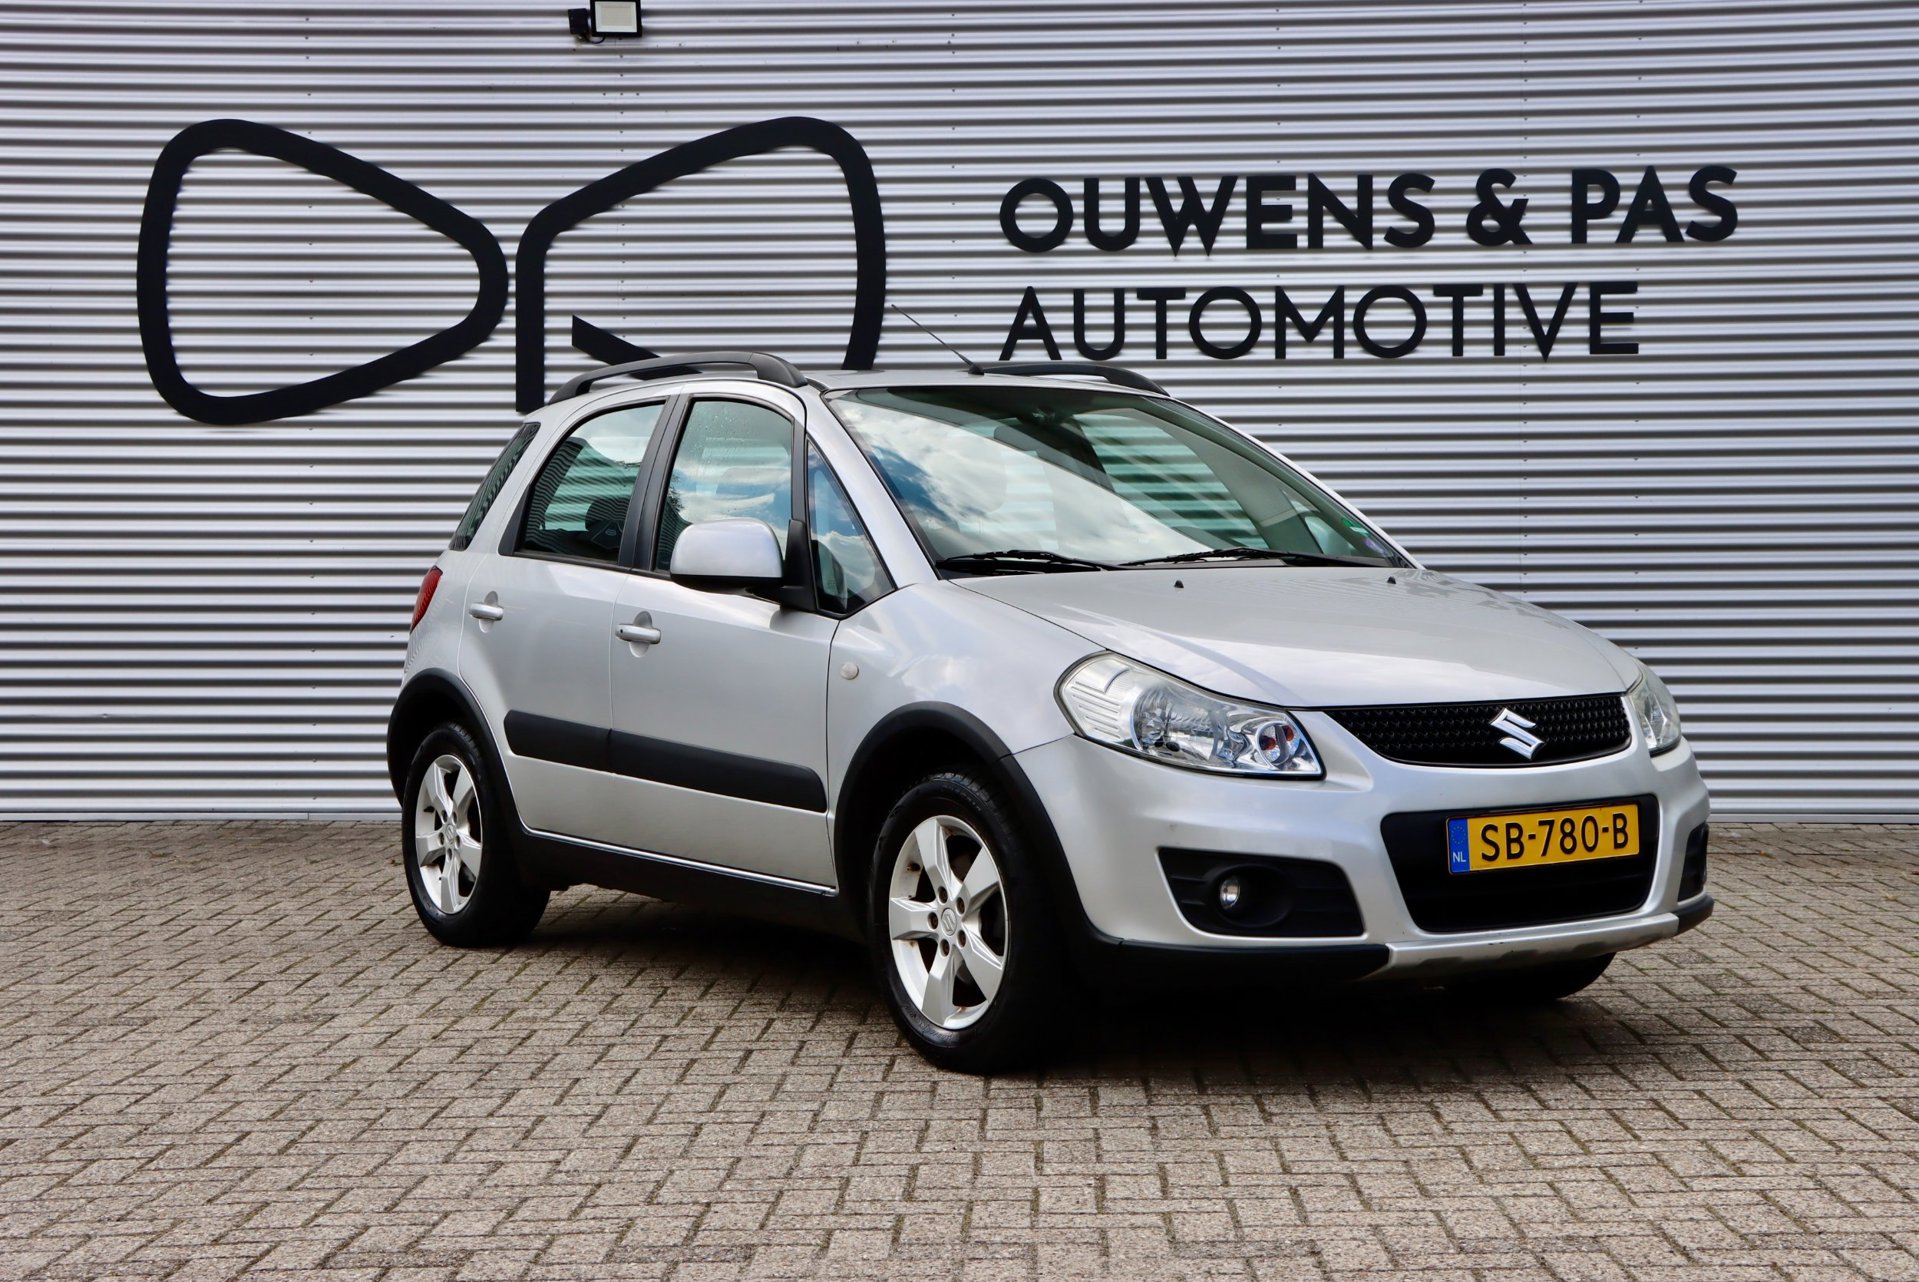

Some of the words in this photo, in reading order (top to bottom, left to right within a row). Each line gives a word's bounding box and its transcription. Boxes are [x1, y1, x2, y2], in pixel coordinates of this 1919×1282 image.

[1000, 173, 1436, 256] OUWENS
[1466, 167, 1533, 248] &
[1571, 165, 1738, 243] PAS
[999, 280, 1639, 362] AUTOMOTIVE
[1452, 852, 1466, 863] NL
[1480, 812, 1629, 862] SB-780-B
